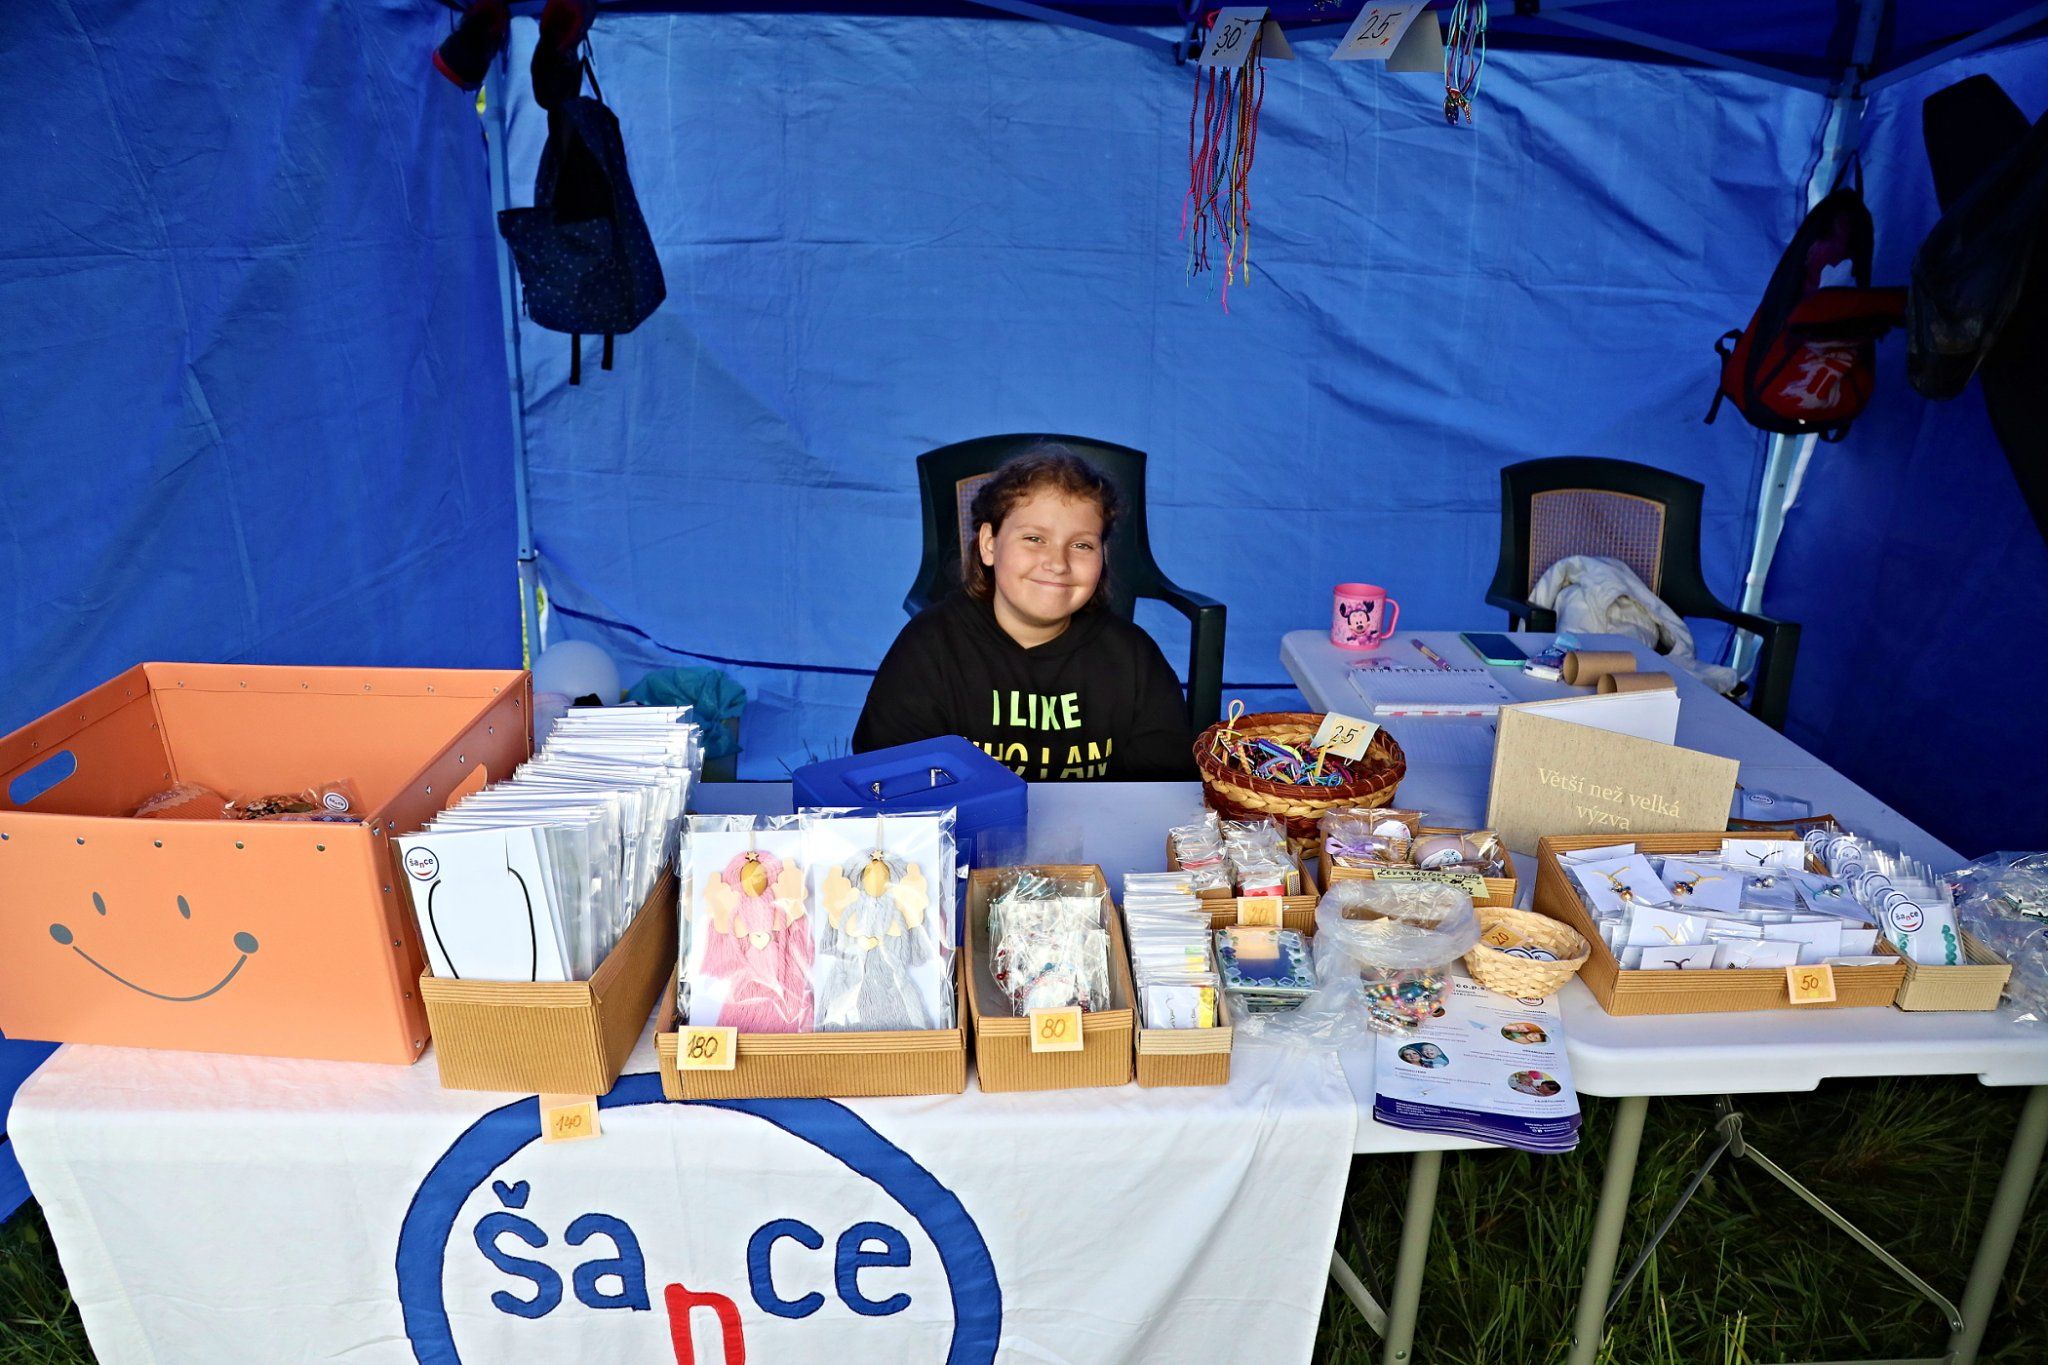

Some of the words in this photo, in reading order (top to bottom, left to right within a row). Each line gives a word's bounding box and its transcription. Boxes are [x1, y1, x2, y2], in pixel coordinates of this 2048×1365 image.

[1216, 24, 1241, 49] 30
[1357, 12, 1402, 41] 25
[992, 689, 1000, 726] I
[1010, 690, 1082, 731] LIKE
[1329, 725, 1359, 745] 25
[1040, 747, 1050, 779] I
[1060, 738, 1112, 779] AM
[1538, 767, 1585, 794] Větší
[1590, 784, 1624, 804] než
[1629, 793, 1680, 818] velká
[1576, 804, 1631, 831] výzva
[408, 857, 434, 869] šance
[1251, 907, 1268, 923] 20
[1895, 911, 1919, 921] šance
[1492, 932, 1510, 946] 20
[1801, 974, 1819, 991] 50
[1041, 1018, 1066, 1039] 80
[687, 1034, 719, 1059] 180
[556, 1114, 582, 1132] 140
[474, 1179, 912, 1365] šance
